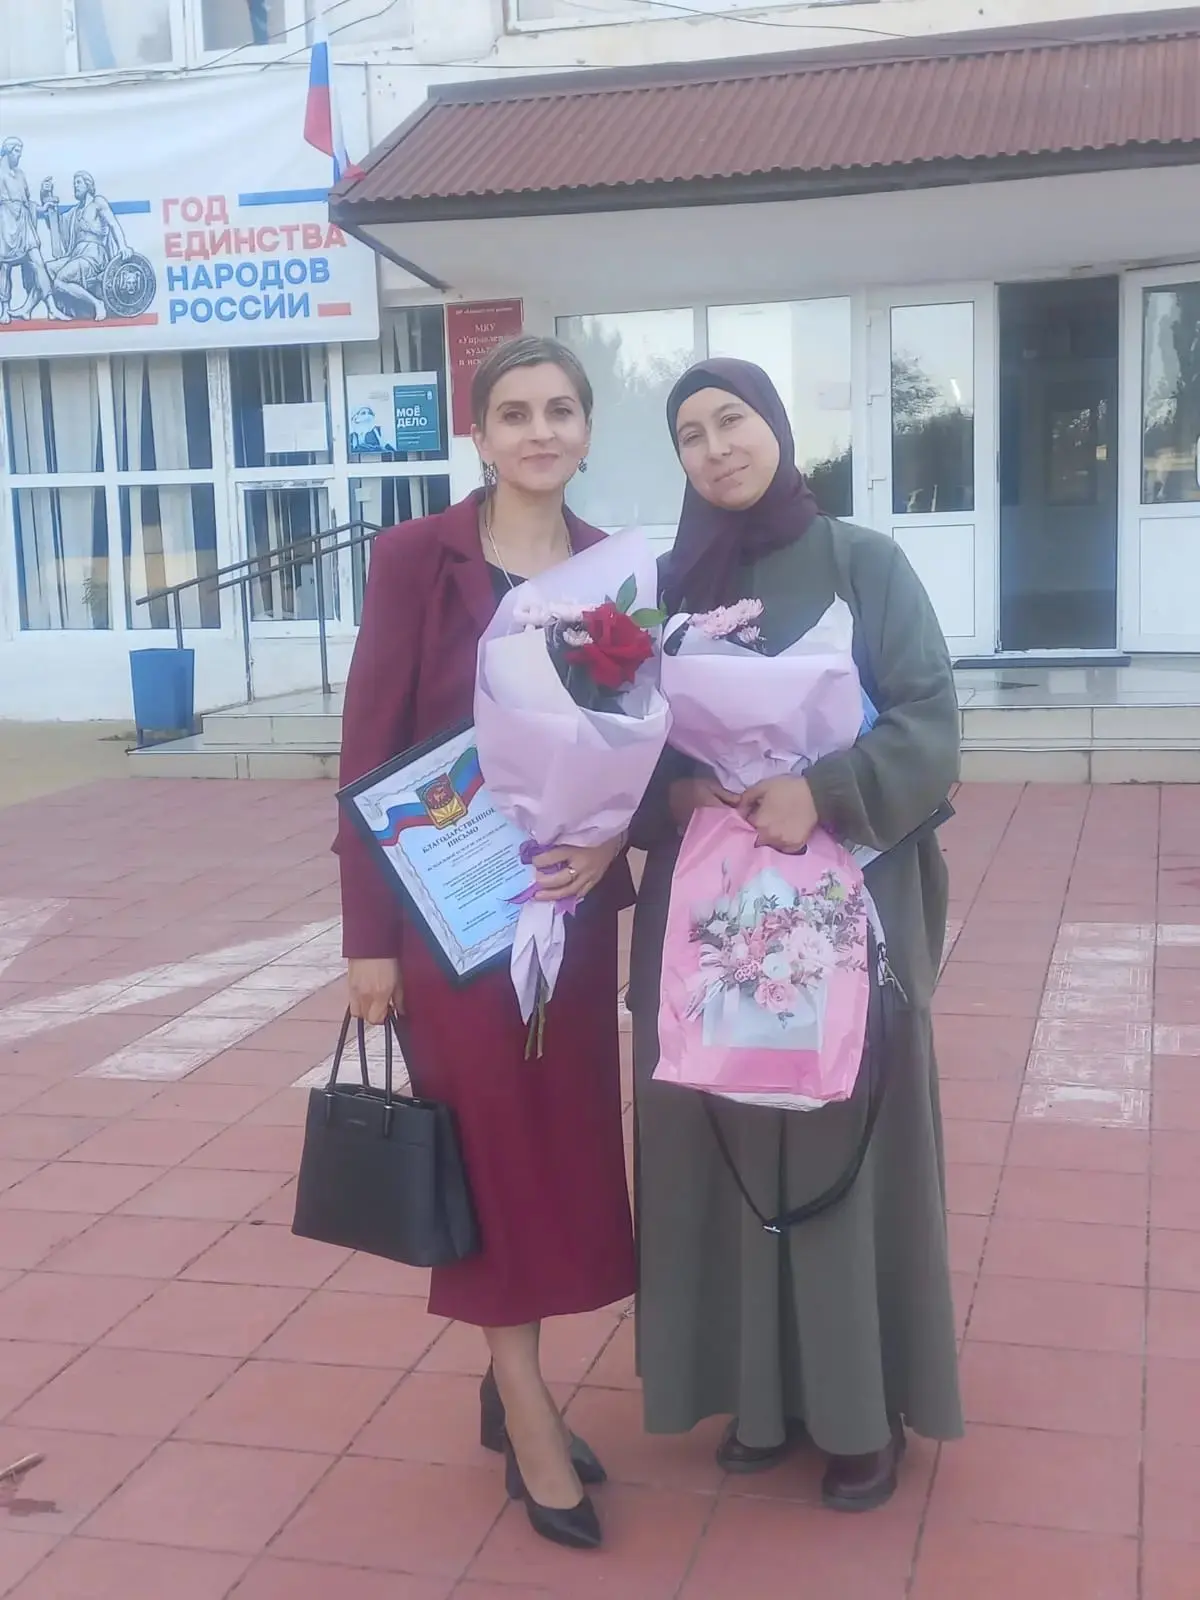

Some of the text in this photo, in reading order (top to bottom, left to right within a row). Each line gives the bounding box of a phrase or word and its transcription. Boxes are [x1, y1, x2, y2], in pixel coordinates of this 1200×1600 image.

[163, 195, 229, 226] ГОД
[164, 223, 347, 262] ЕДИНСТВА
[167, 257, 330, 291] НАРОДОВ
[169, 292, 310, 324] РОССИИ
[475, 323, 495, 333] МКУ
[396, 405, 420, 417] МОЁ
[397, 417, 427, 428] ДЕЛО
[447, 826, 479, 848] ПИСЬМО
